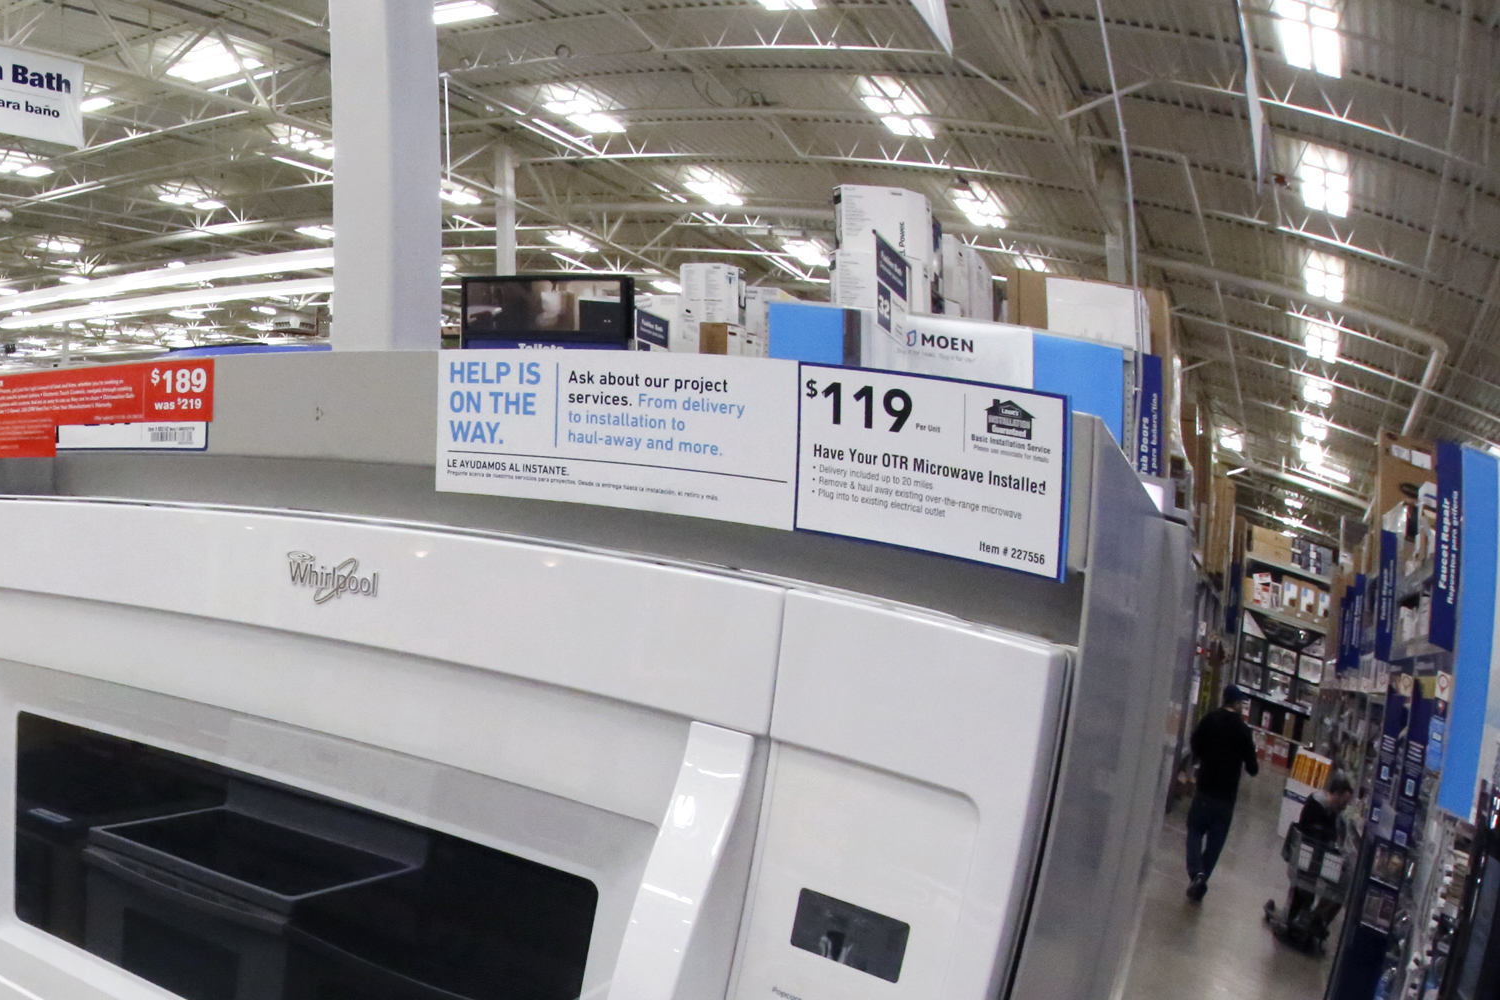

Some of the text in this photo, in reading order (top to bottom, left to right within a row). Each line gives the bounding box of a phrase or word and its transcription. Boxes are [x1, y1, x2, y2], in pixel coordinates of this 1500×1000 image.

[12, 64, 71, 94] Bath
[25, 101, 60, 118] baño
[878, 294, 890, 319] 32
[921, 333, 974, 353] MOEN
[151, 368, 207, 394] $189
[449, 361, 541, 385] HELP IS
[568, 370, 728, 394] Ask about our project
[154, 398, 202, 410] was $219
[449, 390, 537, 416] ON THE
[568, 392, 745, 419] services. From delivery
[805, 378, 913, 433] $119
[449, 420, 504, 445] WAY.
[568, 410, 685, 432] to installation to
[915, 423, 941, 434] Per Unit
[567, 429, 723, 457] haul-away and more.
[971, 433, 1051, 454] Basic Installation Service
[1141, 417, 1149, 455] Doors
[447, 459, 570, 476] LE AYUDAMOS AL INSTANTE.
[813, 443, 1047, 495] Have Your OTR Microwave Installed
[819, 464, 934, 490] Delivery included up to 20 miles
[818, 475, 1023, 520] Remove & haul away existing over-the-range microwave
[818, 488, 946, 518] Plug into to existing electrical outlet
[979, 541, 1046, 565] Item # 227556
[1438, 497, 1450, 589] Faucet Repair
[287, 557, 379, 600] Whirlpool
[1446, 556, 1458, 604] Repuestos
